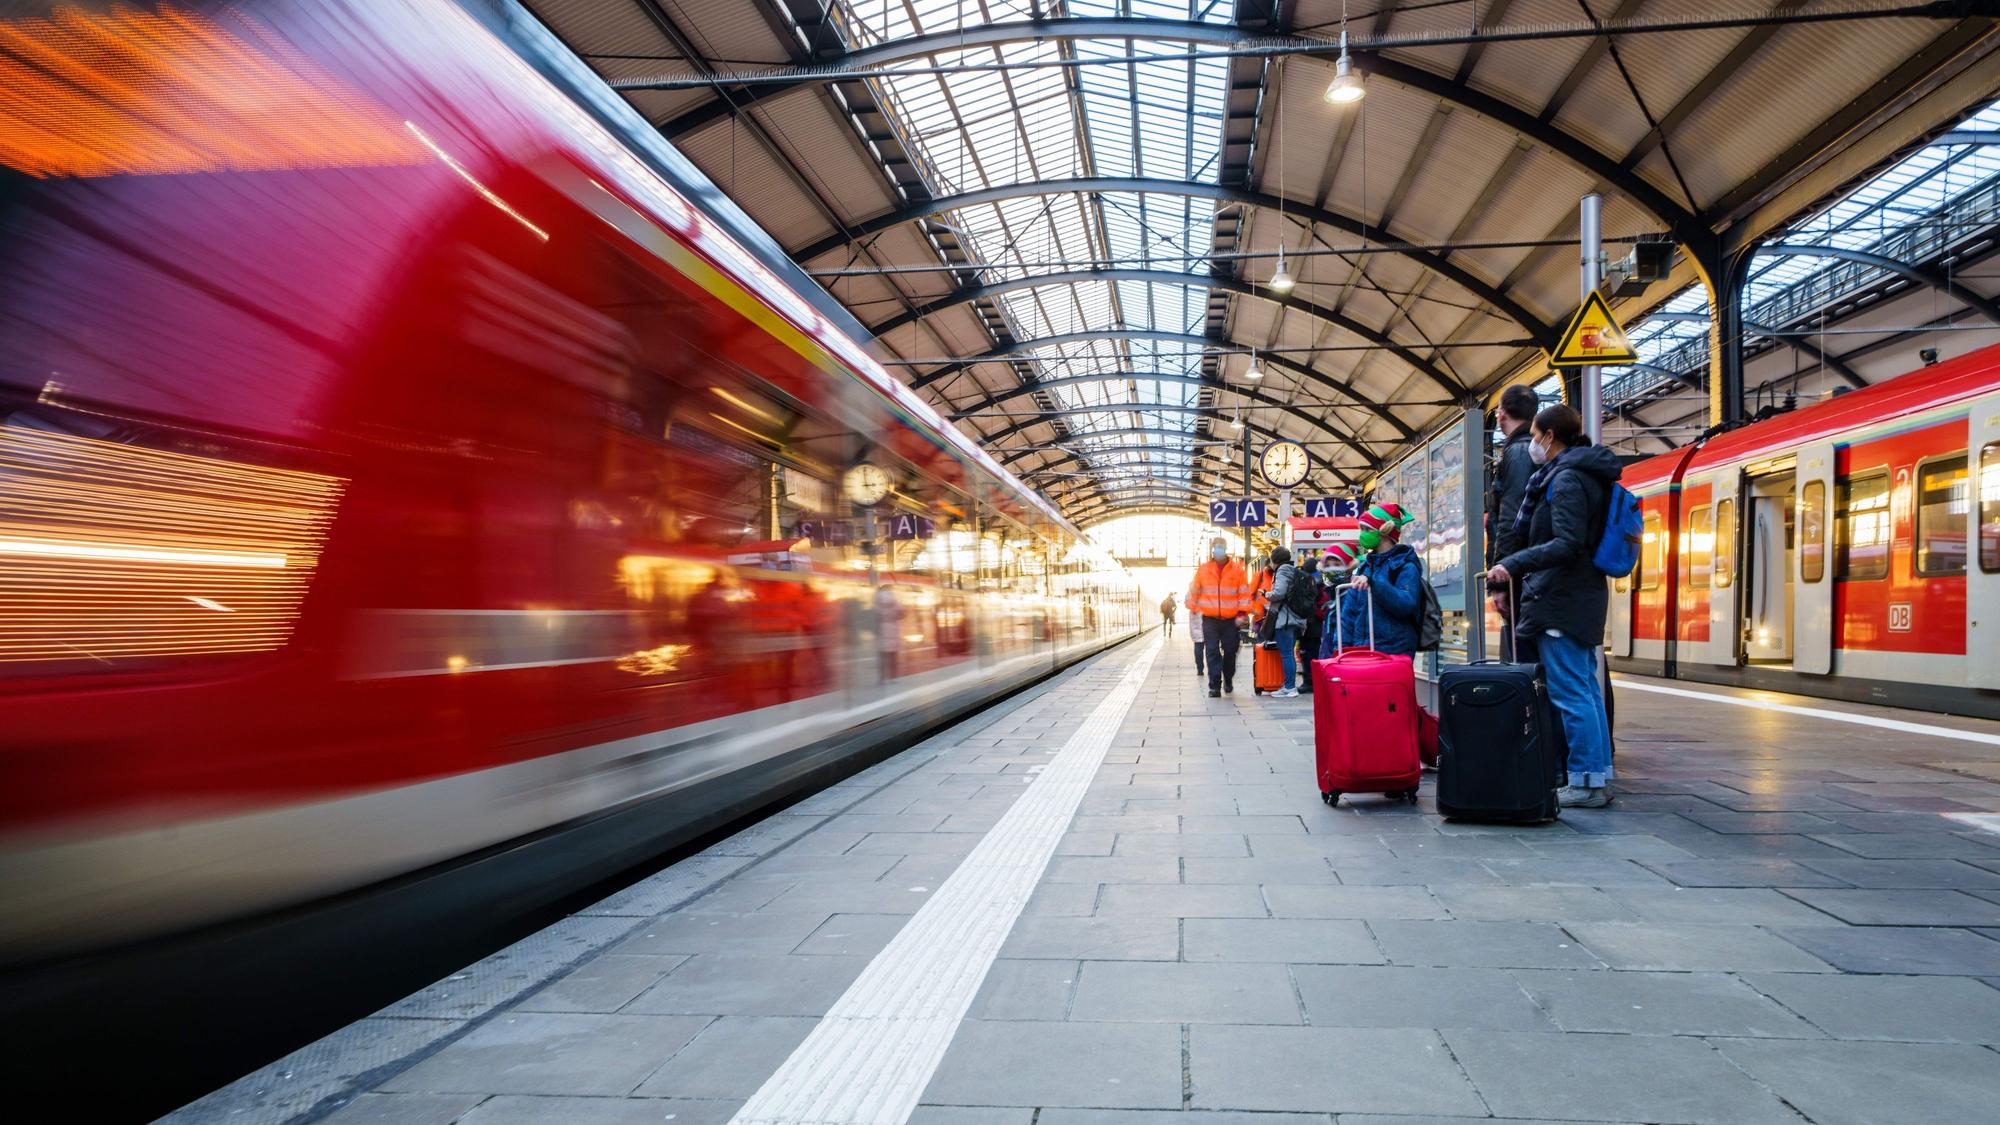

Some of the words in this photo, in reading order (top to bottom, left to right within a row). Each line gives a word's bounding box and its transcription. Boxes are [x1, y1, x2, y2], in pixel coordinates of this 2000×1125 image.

[1213, 502, 1227, 522] 2
[1242, 501, 1259, 521] A
[1314, 500, 1329, 518] A
[1345, 500, 1359, 518] 3
[1890, 606, 1909, 628] DB
